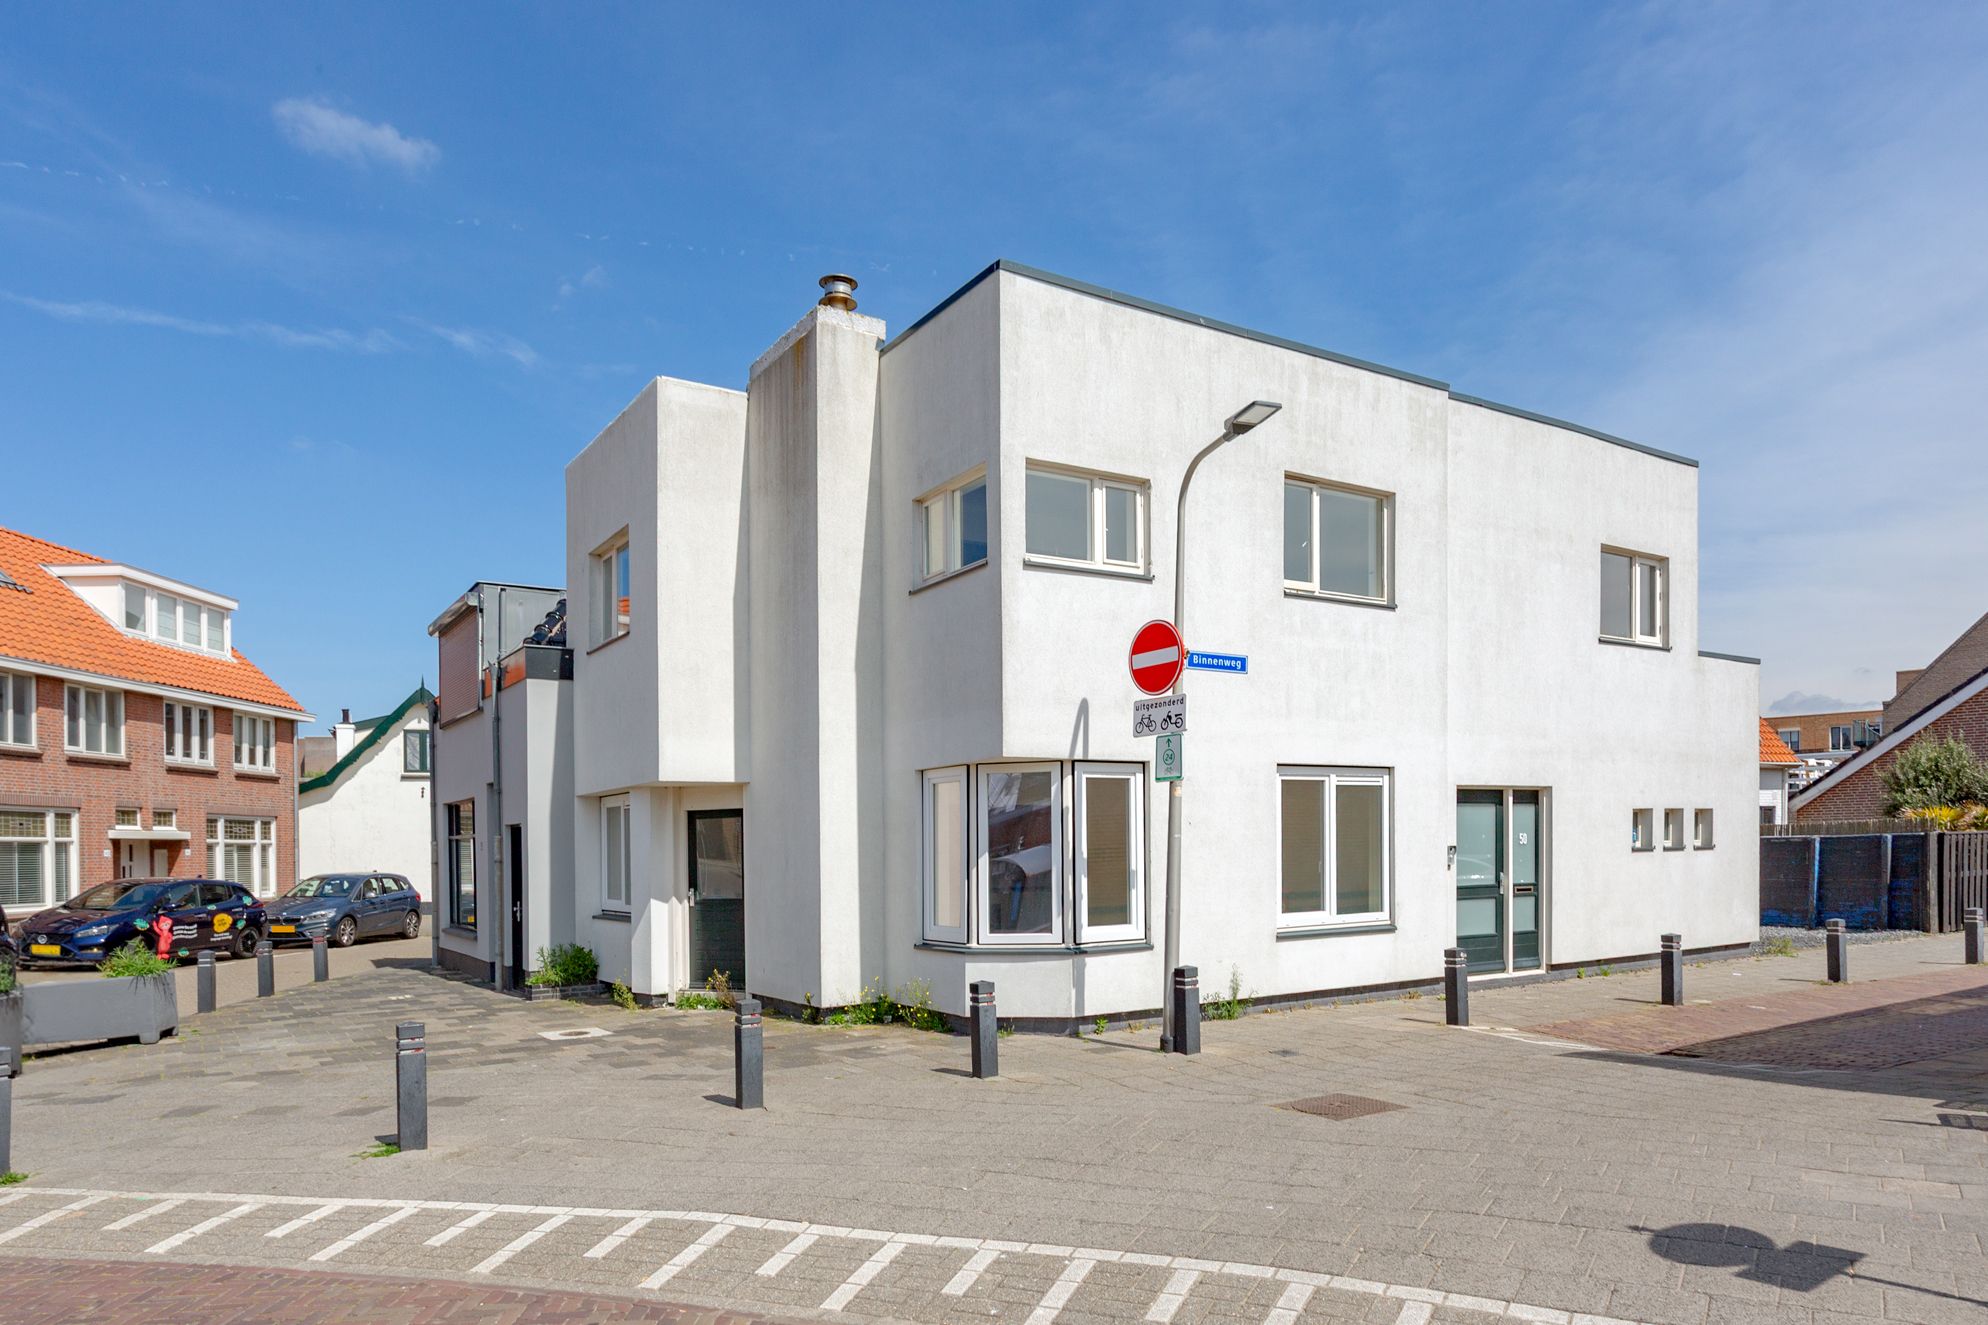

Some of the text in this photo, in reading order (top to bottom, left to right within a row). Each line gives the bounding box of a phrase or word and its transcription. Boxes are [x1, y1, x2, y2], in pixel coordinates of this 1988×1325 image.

[1193, 655, 1242, 669] Binnenweg
[1135, 697, 1184, 711] uitgezonderd
[1165, 753, 1173, 762] 24
[1520, 832, 1528, 844] 50
